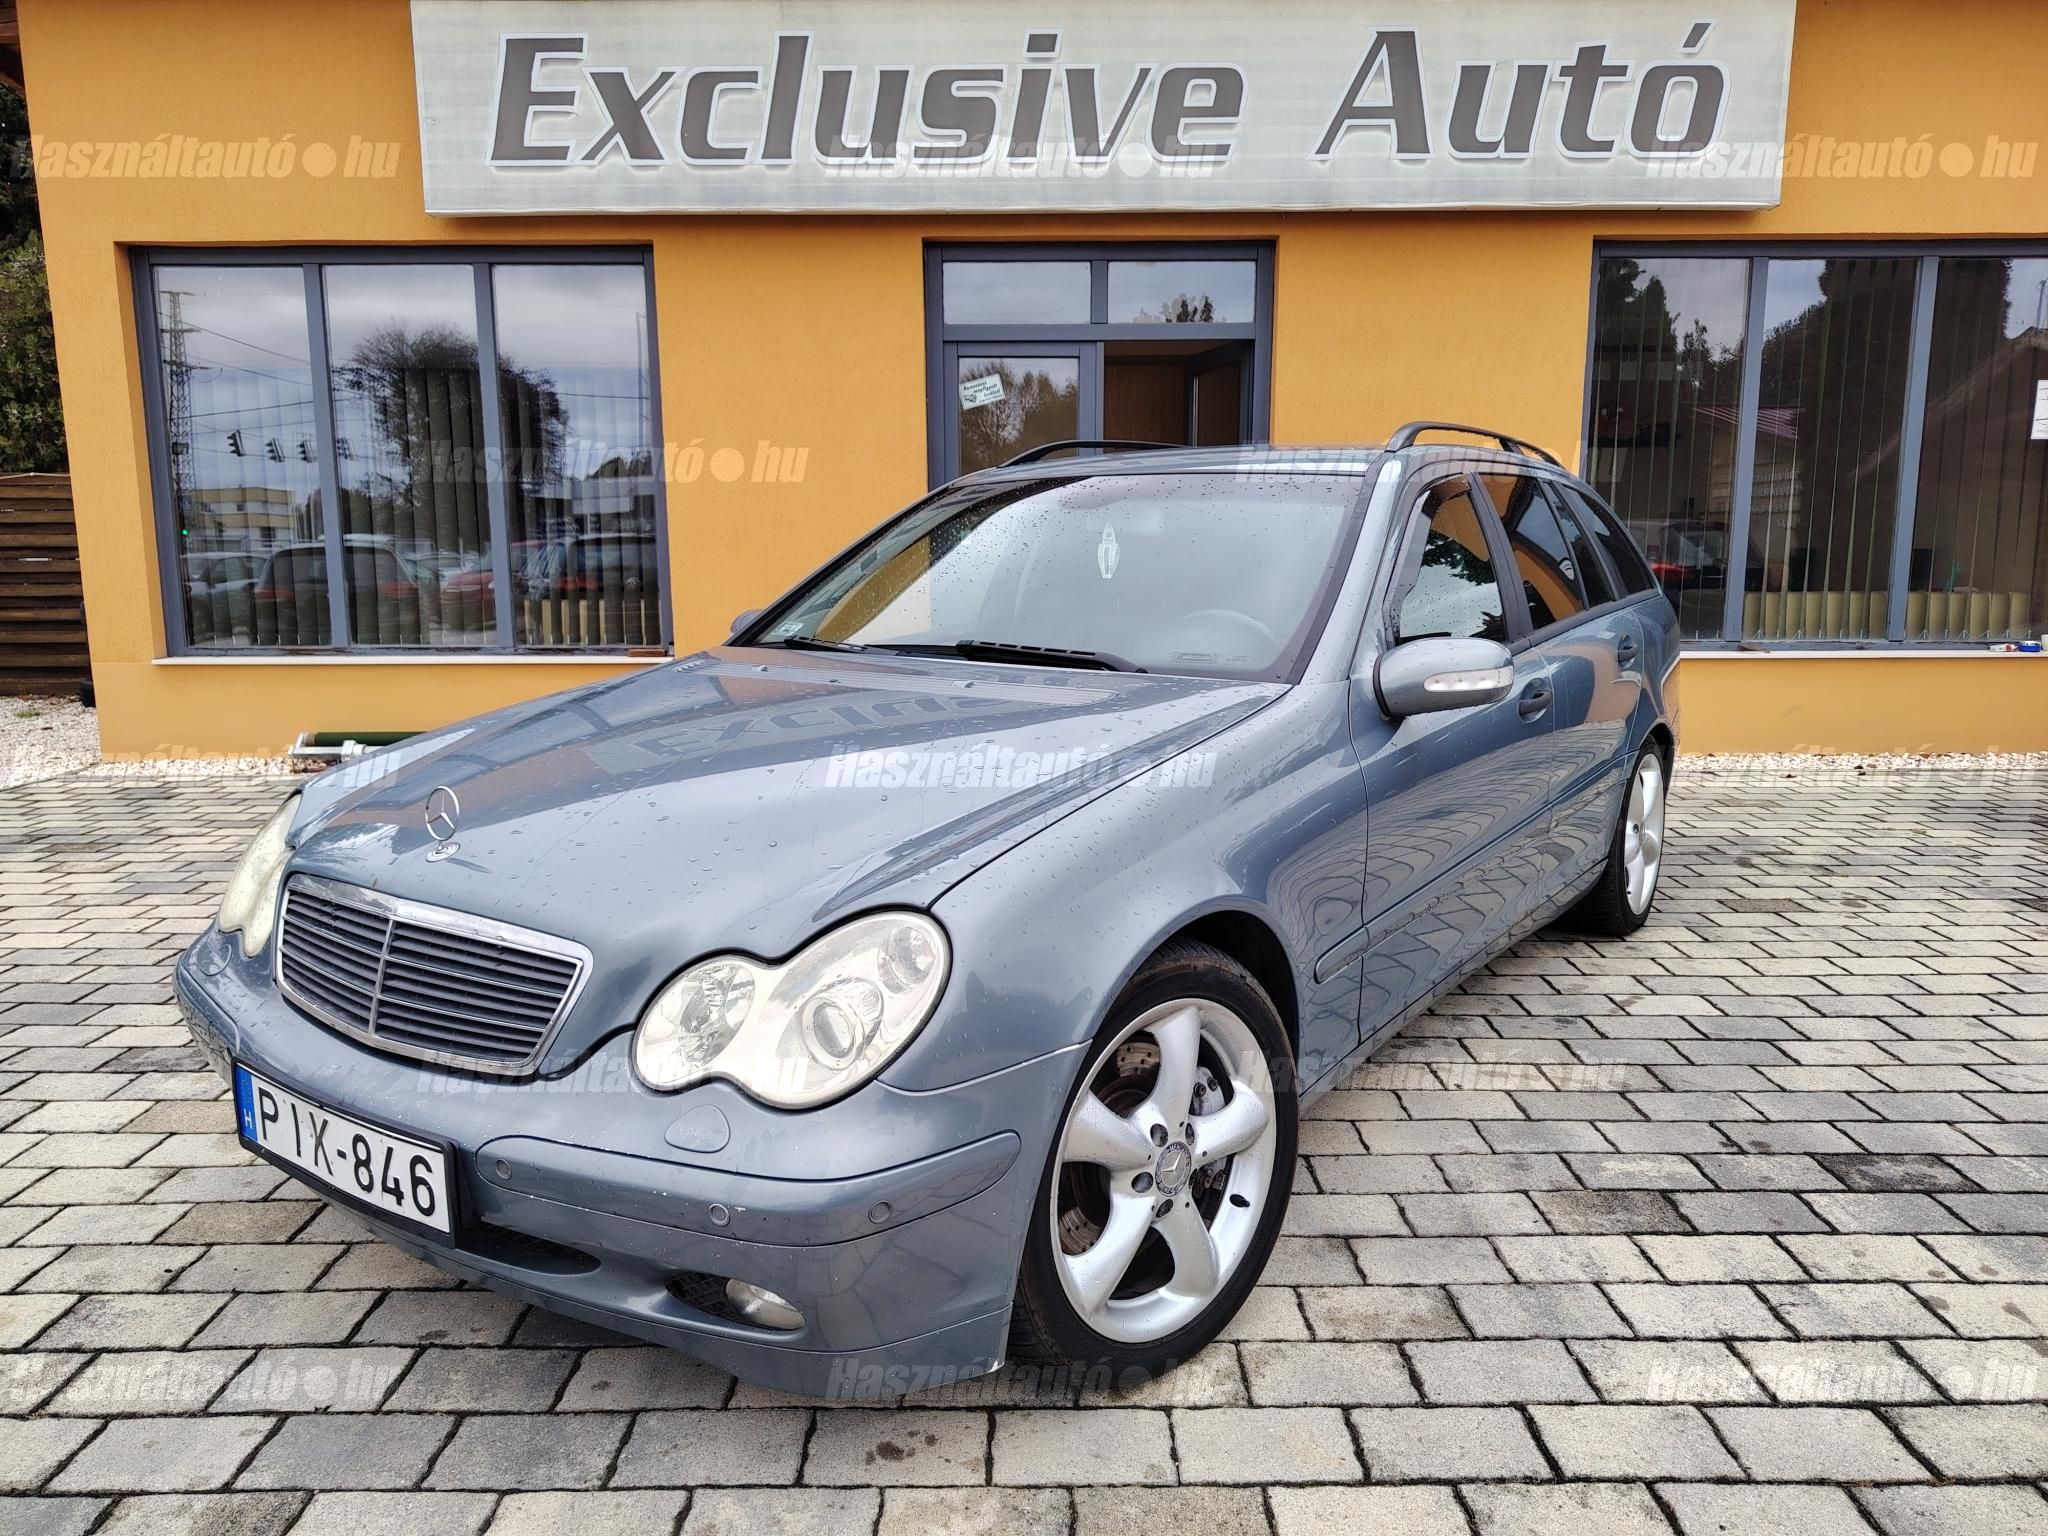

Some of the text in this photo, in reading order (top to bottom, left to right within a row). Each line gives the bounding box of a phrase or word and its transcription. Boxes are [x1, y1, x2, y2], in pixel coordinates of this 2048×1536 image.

[483, 19, 1731, 168] Exclusive Autó
[243, 1109, 253, 1129] H
[258, 1086, 436, 1217] PIX-846
